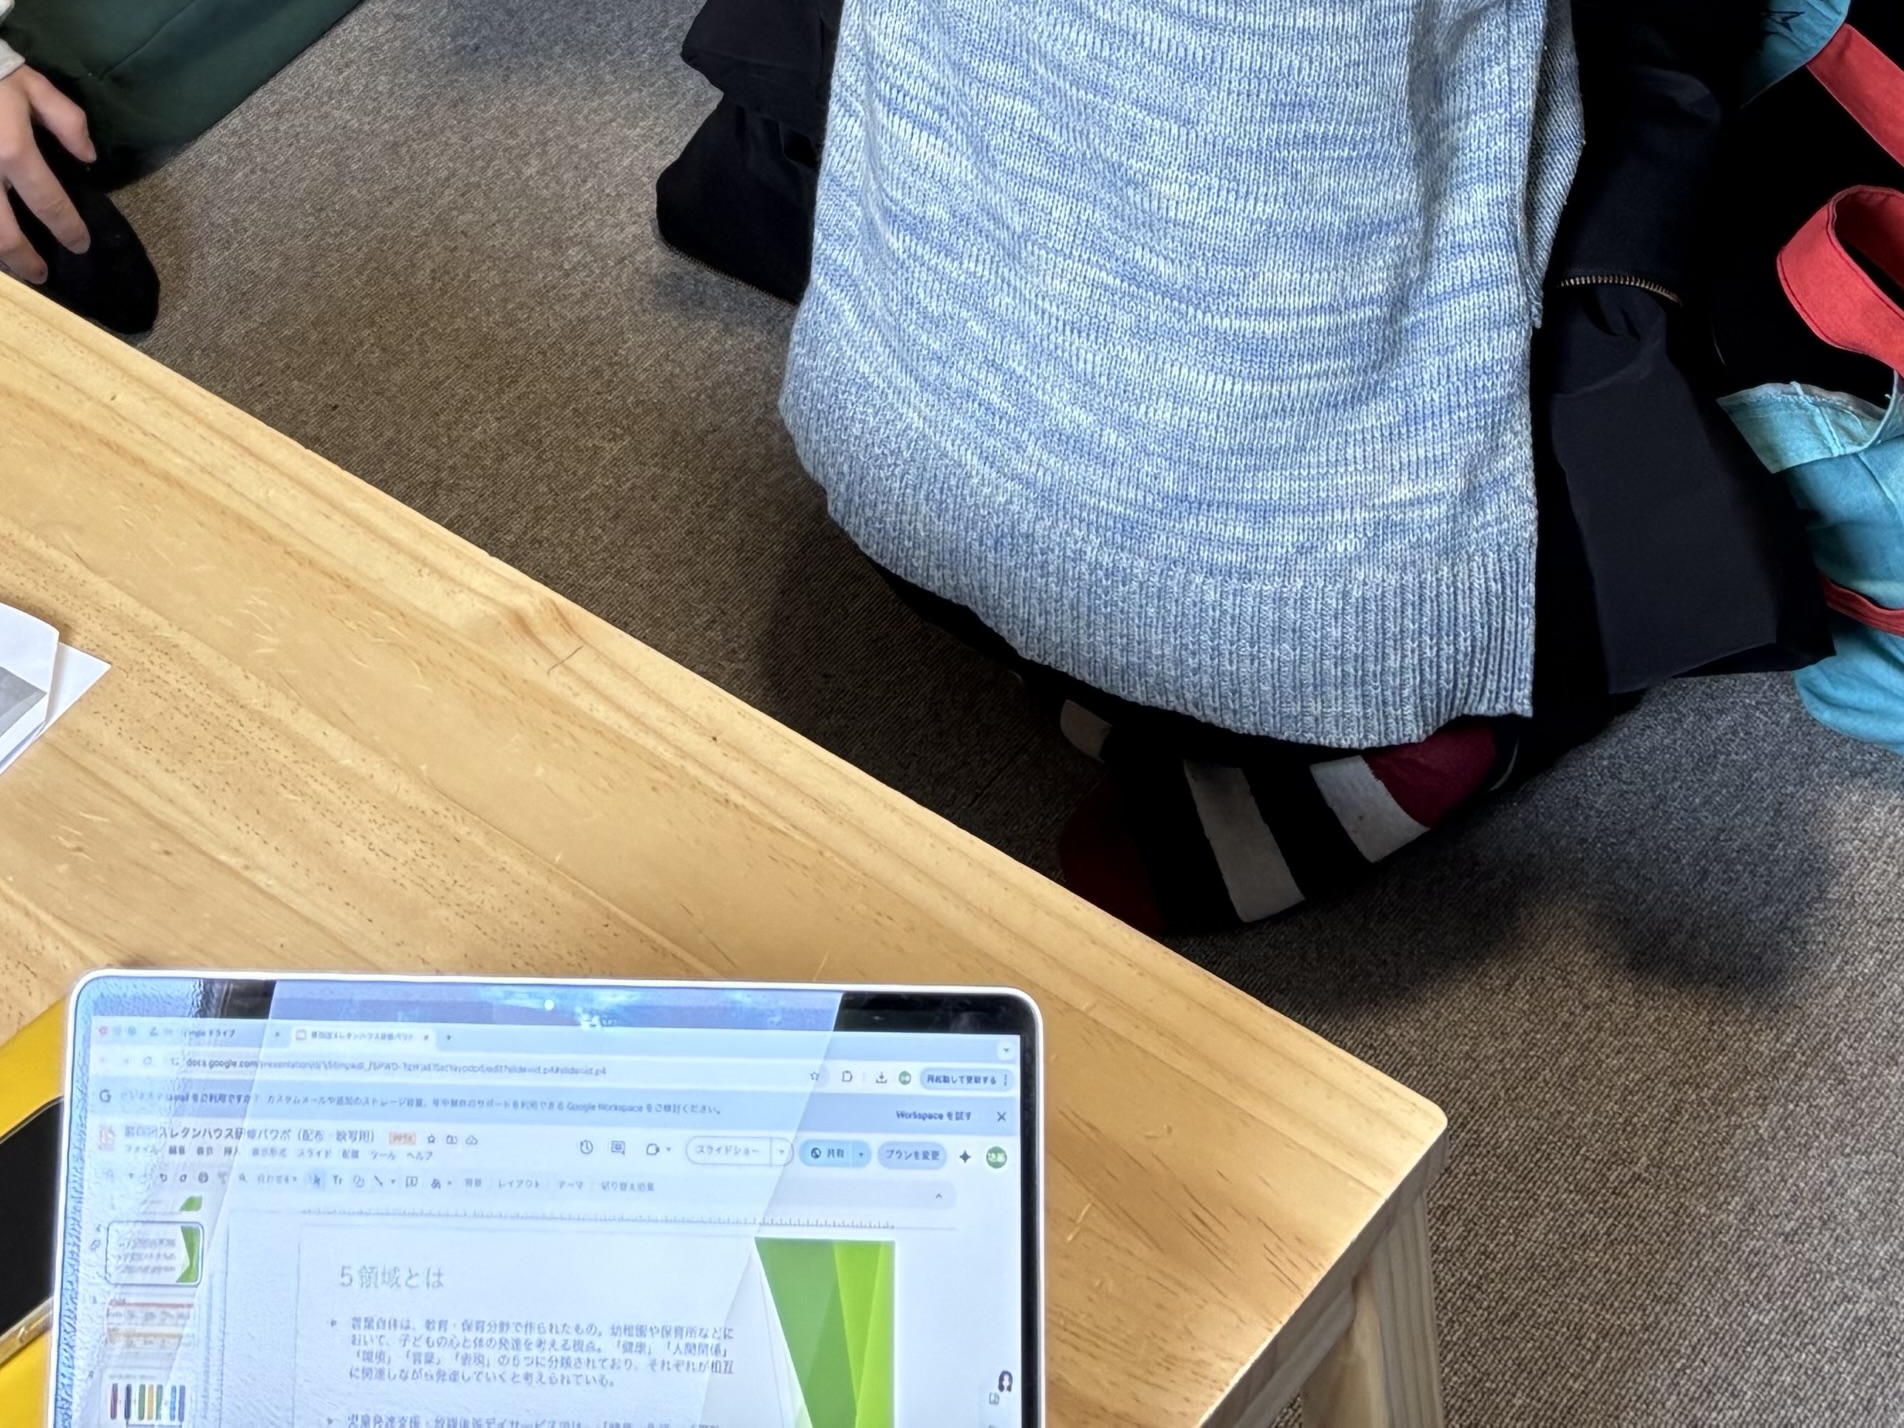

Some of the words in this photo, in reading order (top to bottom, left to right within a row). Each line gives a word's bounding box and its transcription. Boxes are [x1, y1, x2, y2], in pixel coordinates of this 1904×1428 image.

[895, 1110, 944, 1121] Workspace
[339, 1264, 445, 1290] 5領域とは
